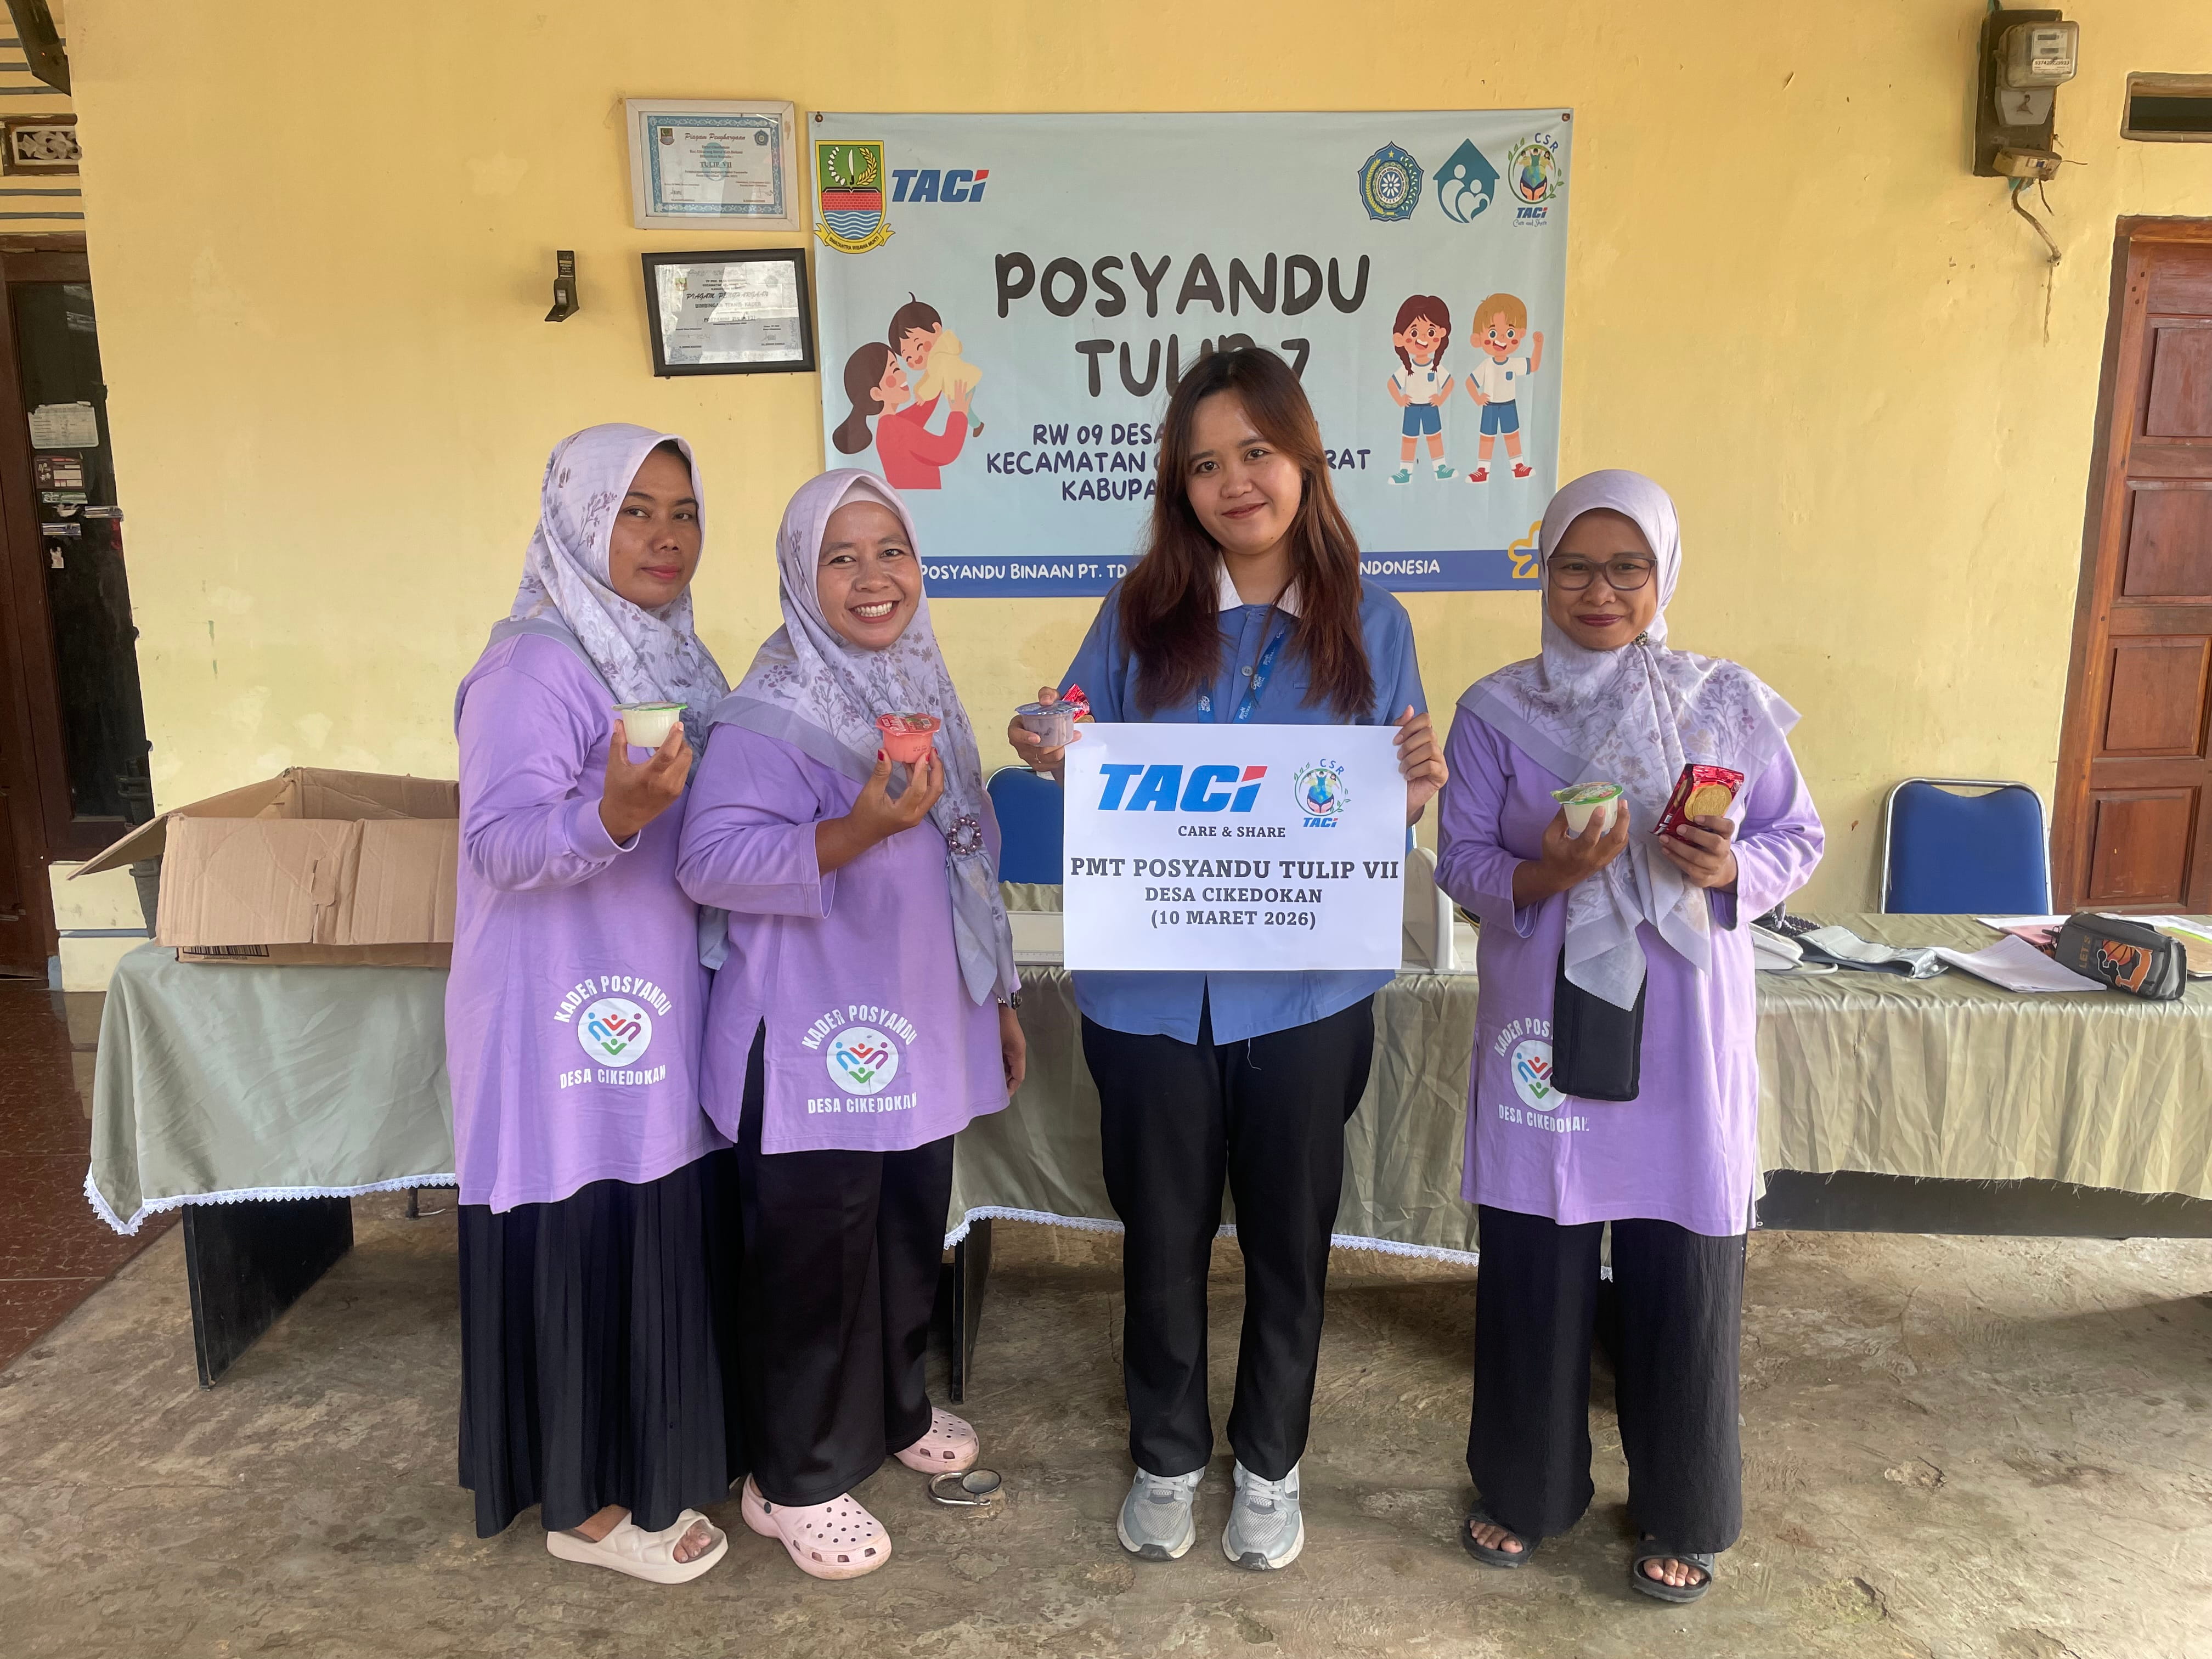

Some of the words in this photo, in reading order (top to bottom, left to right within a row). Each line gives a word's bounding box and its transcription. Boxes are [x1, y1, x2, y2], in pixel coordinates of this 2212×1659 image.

[685, 133, 707, 141] Piagam
[709, 133, 745, 142] Penghargaan
[1534, 132, 1559, 153] CSR
[995, 252, 1370, 318] POSYANDU
[686, 292, 715, 301] PIAGAM
[1075, 333, 1256, 397] TUL
[1033, 424, 1069, 445] RW
[1077, 424, 1103, 445] 09
[988, 451, 1146, 475] KECAMATAN
[1324, 448, 1371, 470] RAT
[1062, 478, 1156, 501] KABUPA
[922, 564, 1006, 580] POSYANDU
[1011, 564, 1074, 579] BINAAN
[1078, 563, 1102, 579] PT.
[1359, 559, 1440, 575] NDONESIA
[1320, 758, 1345, 776] CSR
[1178, 826, 1217, 837] CARE
[1222, 826, 1232, 837] &
[1237, 826, 1286, 838] SHARE
[1071, 857, 1125, 877] PMT
[1134, 859, 1271, 878] POSYANDU
[1279, 861, 1355, 879] TULIP
[1363, 861, 1399, 879] VII
[1146, 887, 1195, 902] DESA
[1203, 887, 1322, 903] CIKEDOKAN
[1151, 910, 1180, 930] (10
[1186, 910, 1257, 926] MARET
[1264, 911, 1317, 930] 2026)
[554, 978, 597, 1023] KADER
[601, 975, 672, 1016] POSYANDU
[802, 1009, 846, 1050] KADER
[849, 1005, 917, 1045] POSYANDU
[1494, 1019, 1523, 1057] KADER
[560, 1068, 592, 1089] DESA
[597, 1064, 666, 1085] CIKEDOKAN
[808, 1098, 841, 1114] DESA
[1498, 1104, 1523, 1124] DESA
